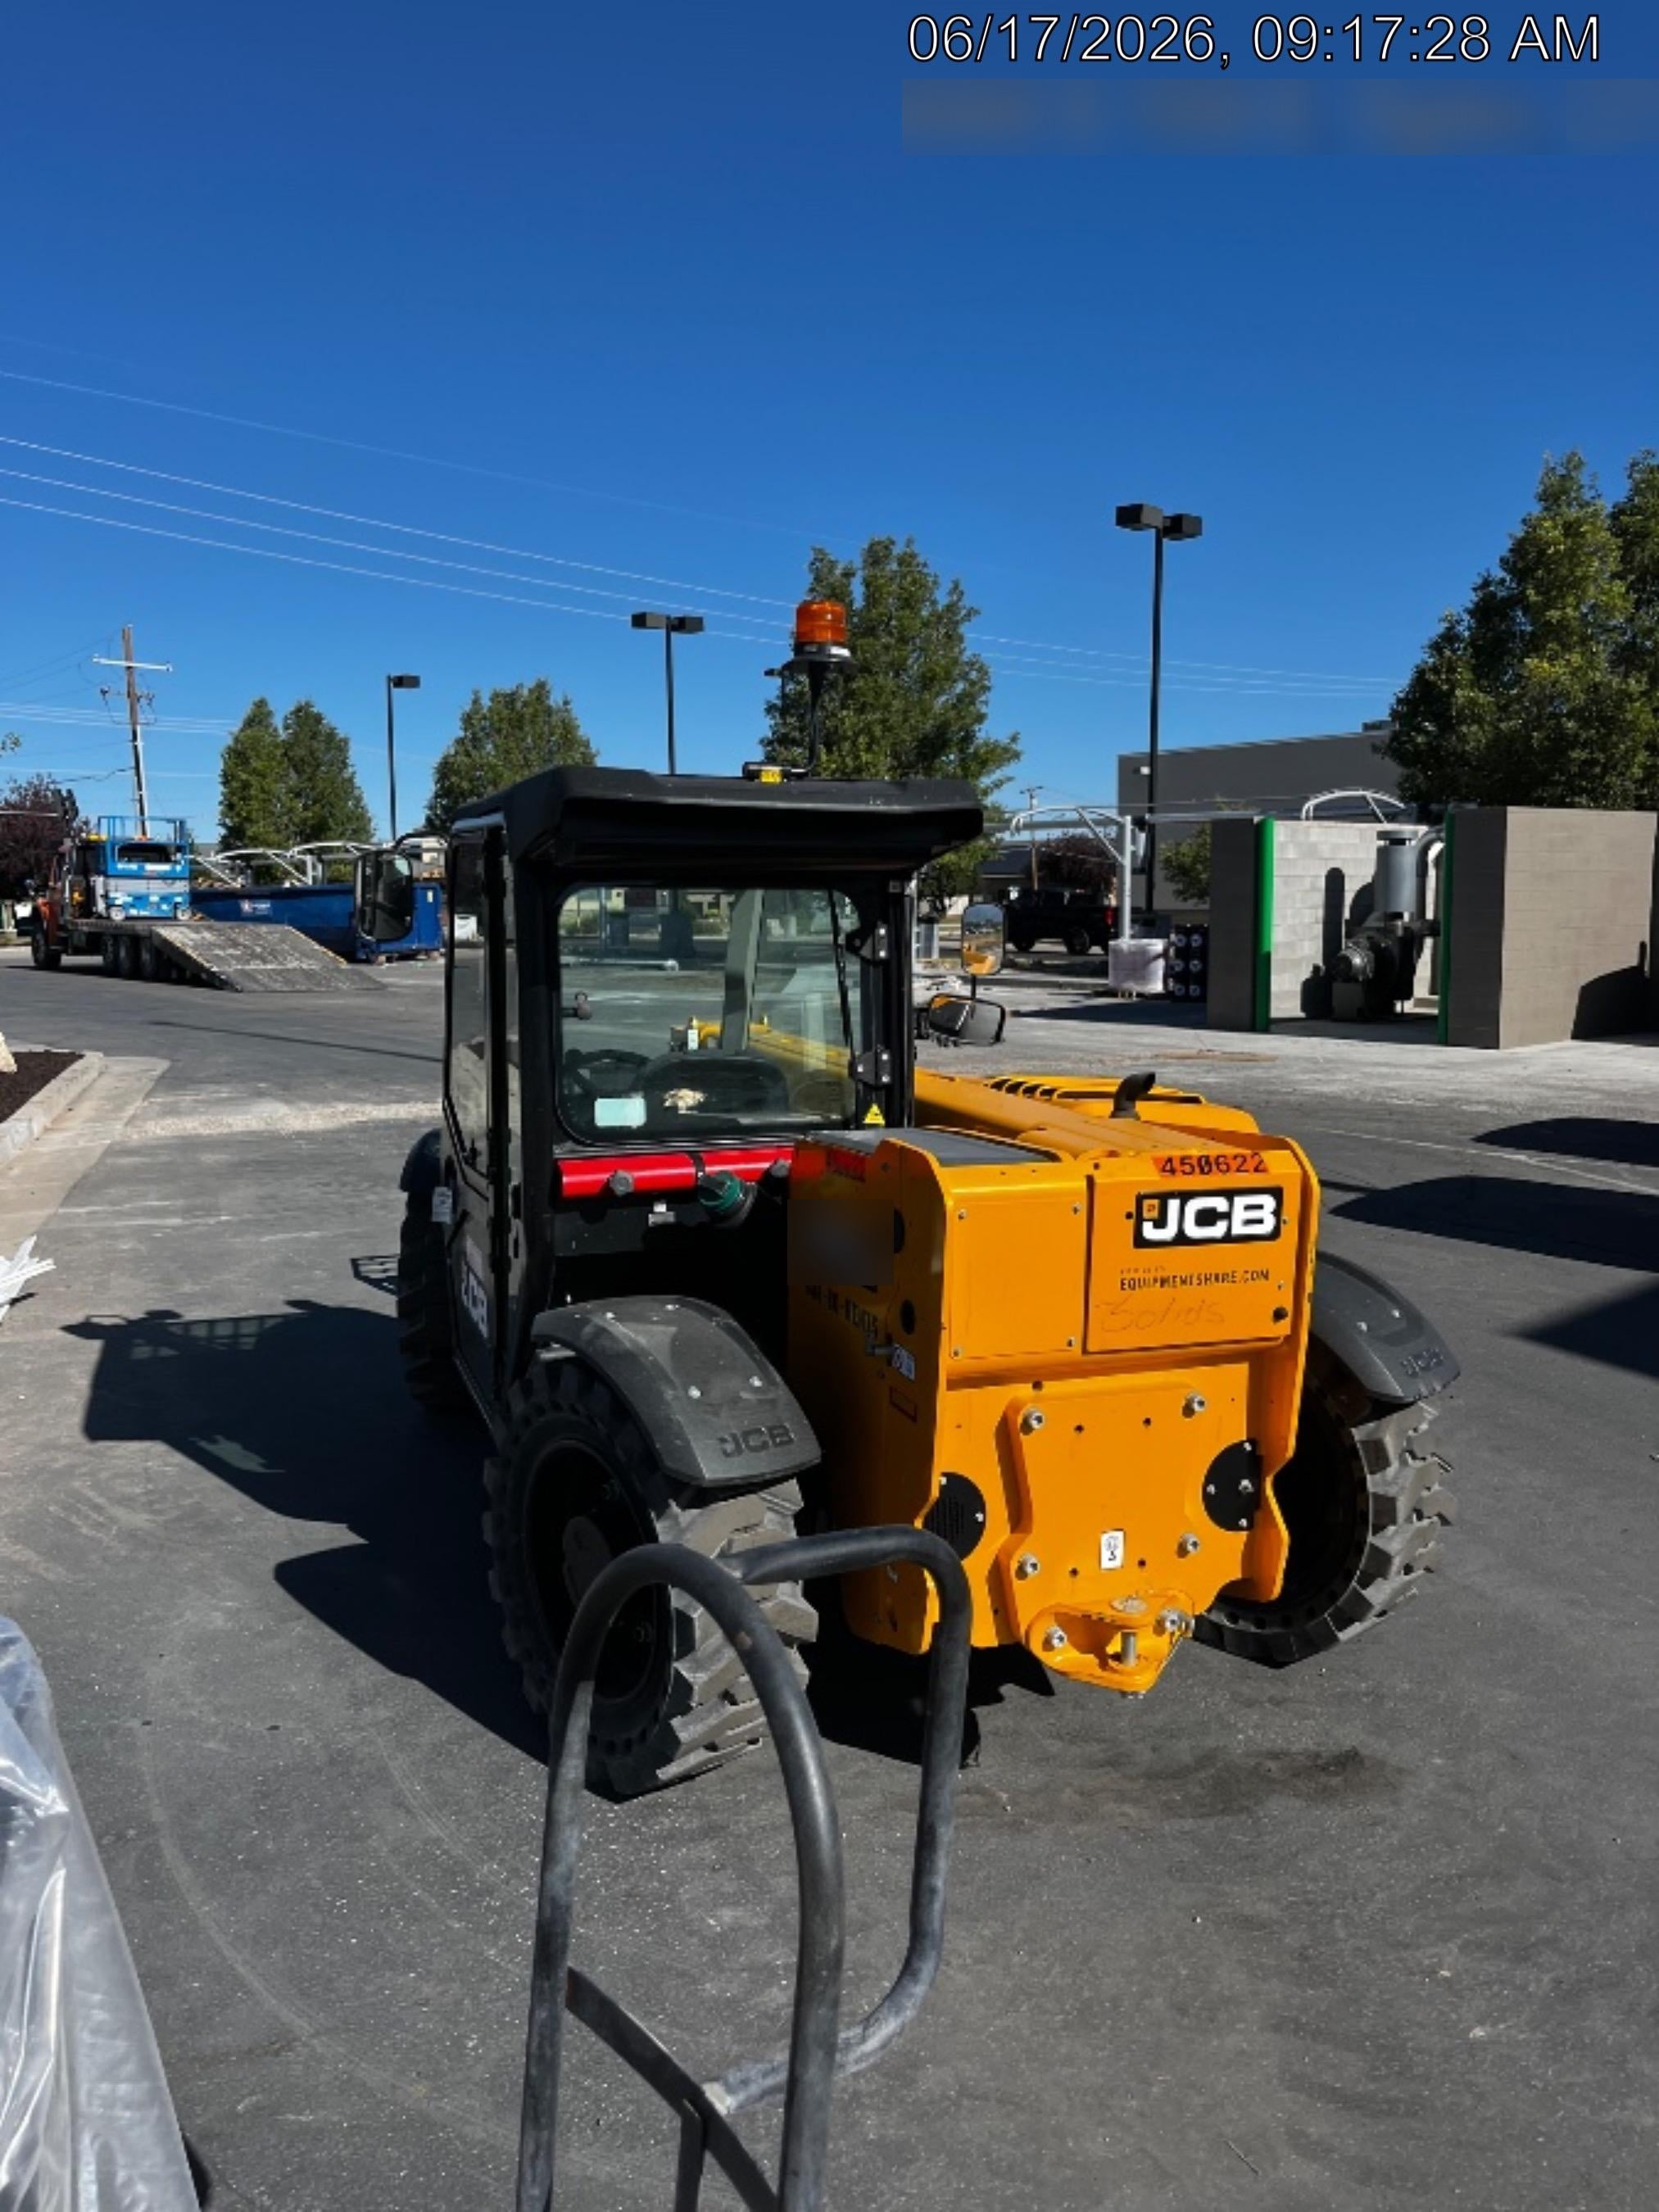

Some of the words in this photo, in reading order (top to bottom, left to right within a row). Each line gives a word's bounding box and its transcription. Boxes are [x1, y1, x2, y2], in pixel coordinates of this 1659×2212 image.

[1161, 1152, 1267, 1176] 450622
[1142, 1194, 1276, 1241] JCB
[719, 1424, 794, 1458] JCB
